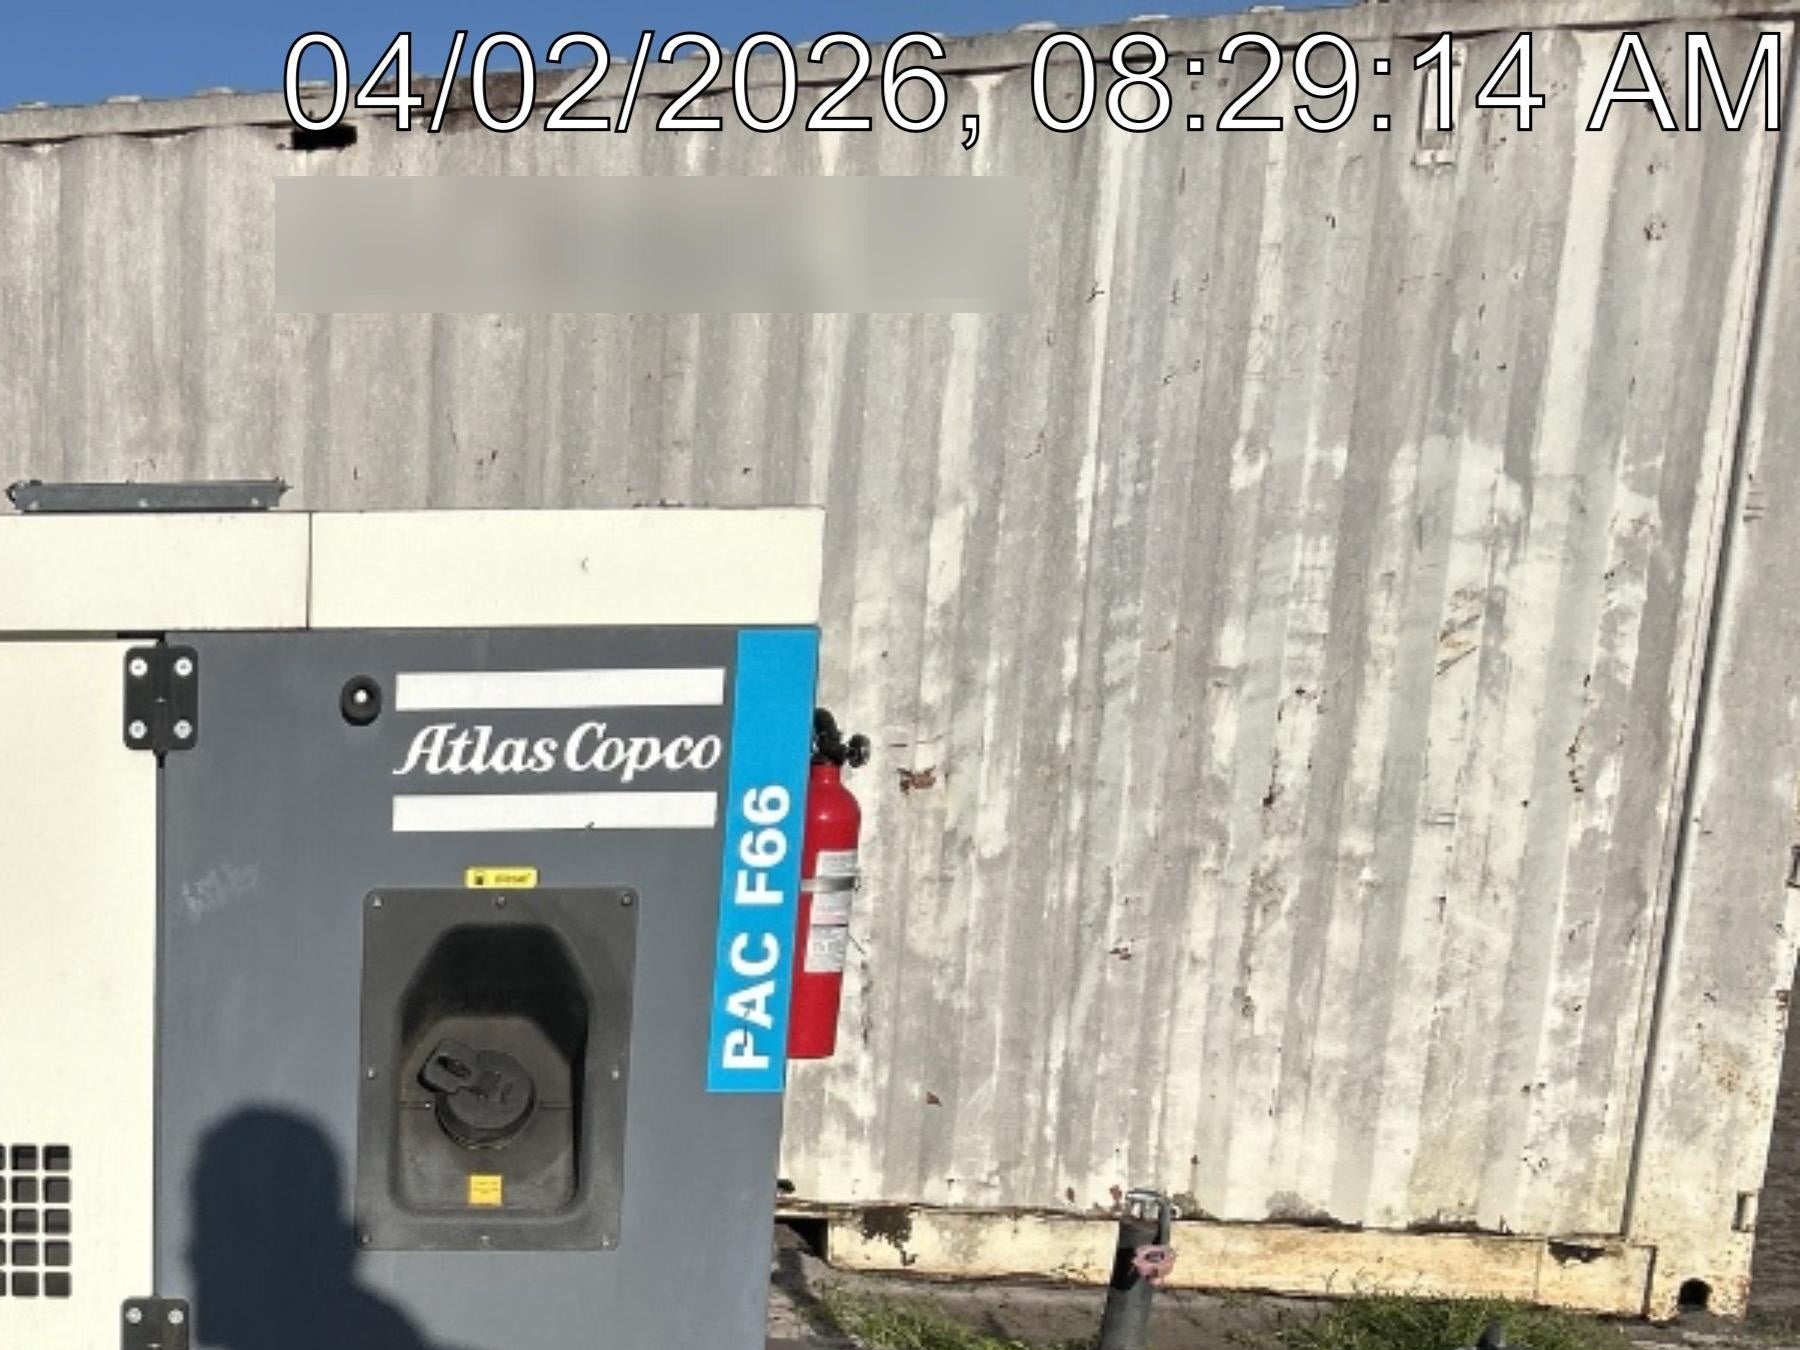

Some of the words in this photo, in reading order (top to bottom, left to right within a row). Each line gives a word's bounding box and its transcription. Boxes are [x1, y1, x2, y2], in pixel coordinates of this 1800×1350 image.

[392, 722, 558, 776] Atlas
[563, 721, 722, 783] Copco
[734, 784, 791, 905] F66
[722, 932, 780, 1070] PAC
